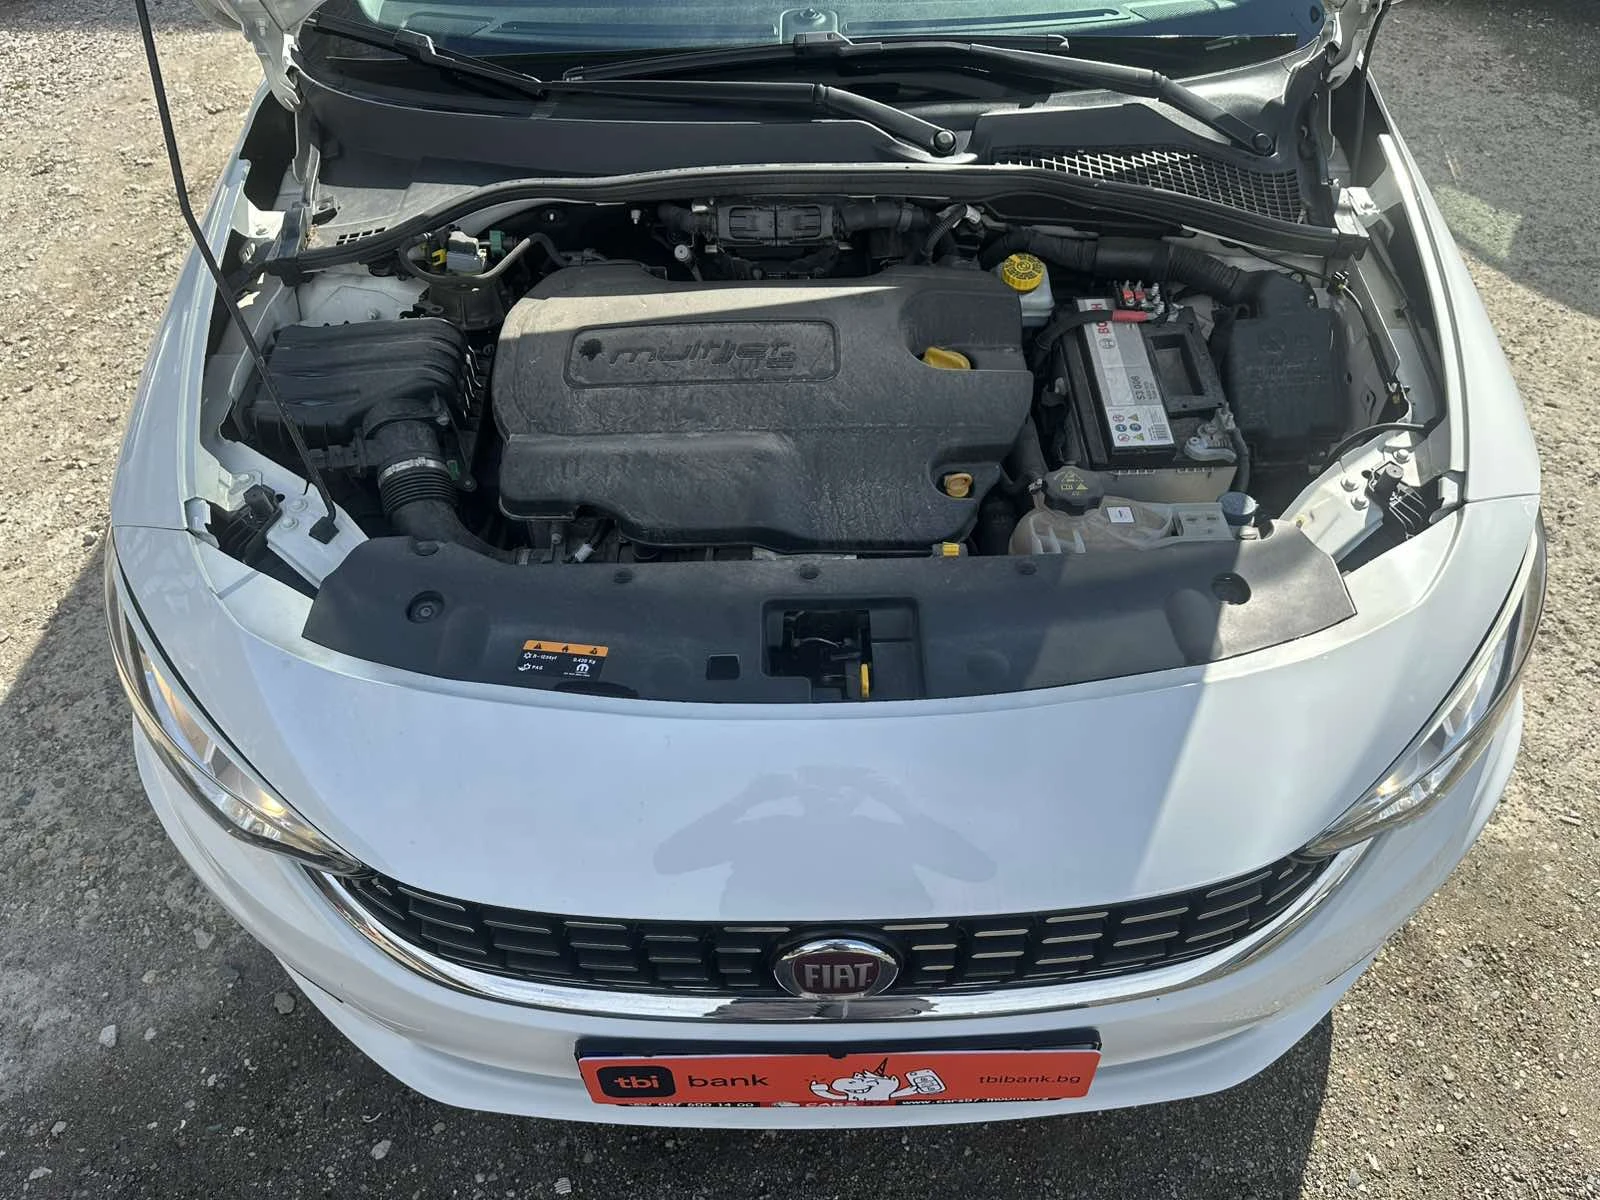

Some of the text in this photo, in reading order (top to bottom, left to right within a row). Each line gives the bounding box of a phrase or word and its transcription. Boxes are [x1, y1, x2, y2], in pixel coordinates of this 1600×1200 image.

[803, 962, 874, 989] FIAT
[614, 1074, 769, 1089] tbi bank
[979, 1074, 1081, 1085] tbibank.bg
